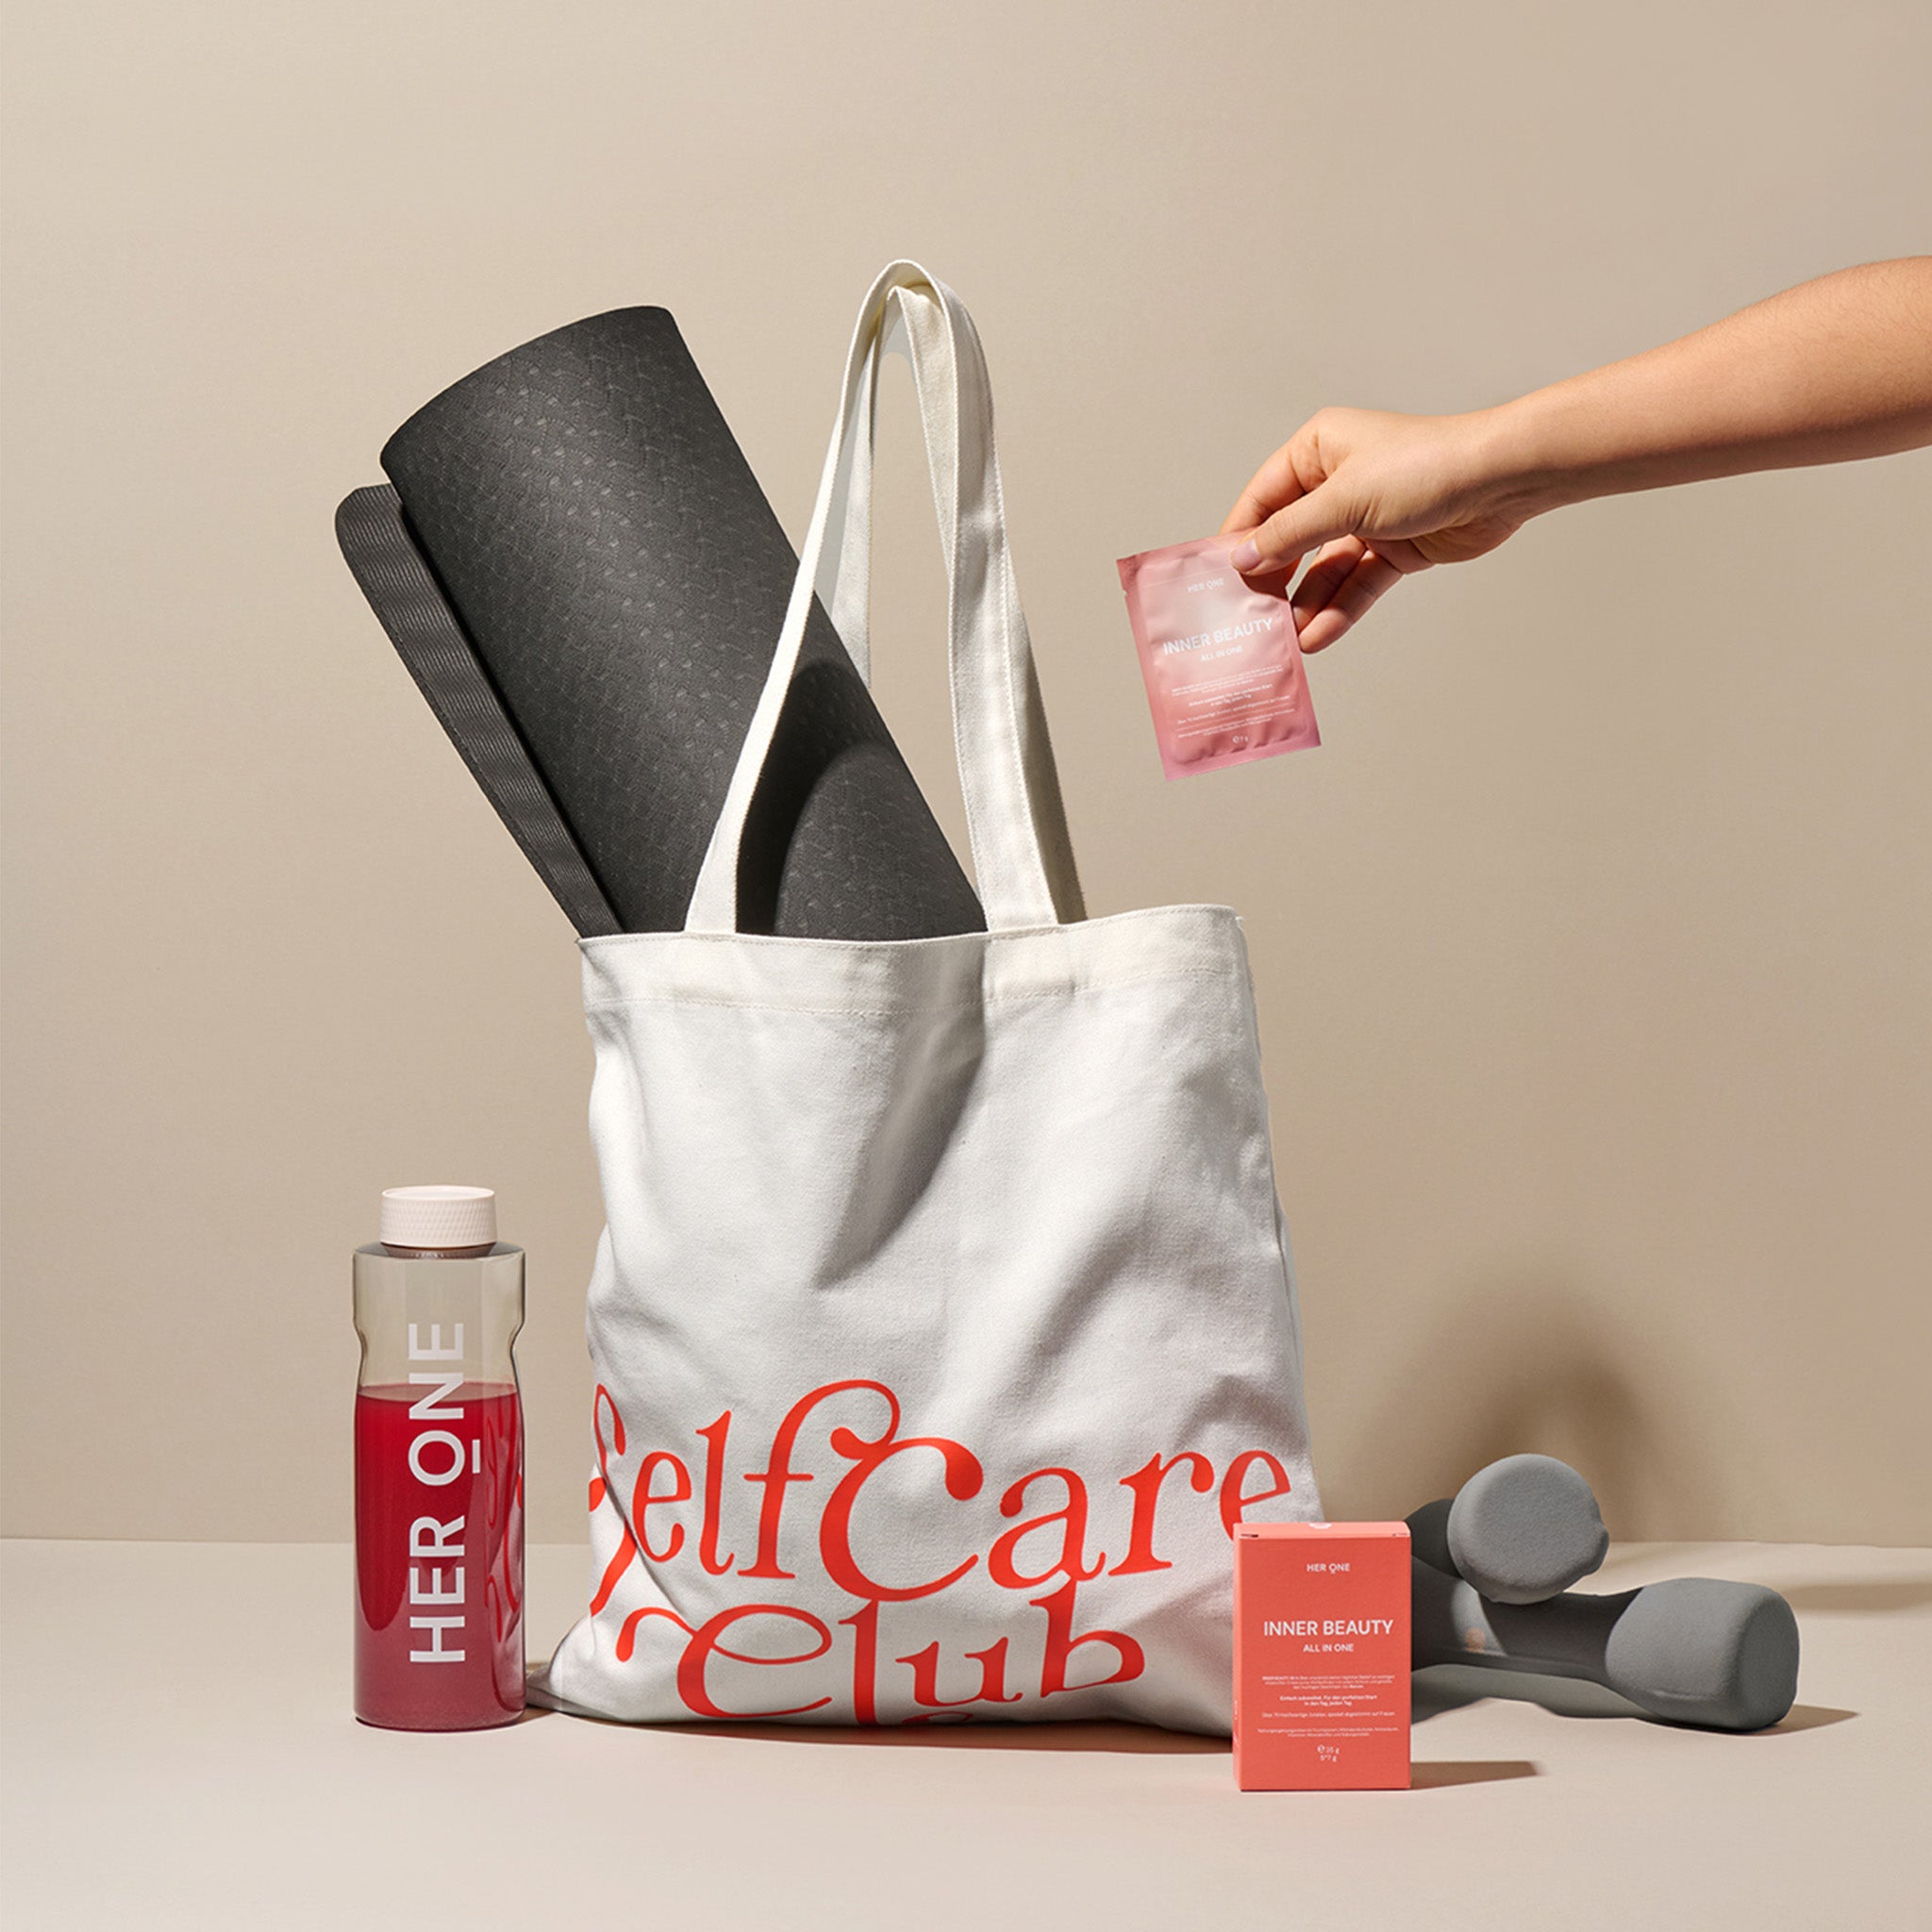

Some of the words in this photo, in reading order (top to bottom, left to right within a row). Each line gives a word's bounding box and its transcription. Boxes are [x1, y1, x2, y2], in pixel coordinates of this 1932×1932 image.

[1162, 633, 1211, 656] INNER
[1213, 617, 1274, 643] BEAUTY
[1200, 652, 1216, 663] ALL
[1216, 649, 1226, 659] IN
[1226, 645, 1243, 658] ONE
[408, 1324, 481, 1486] ONE
[1307, 1563, 1326, 1572] HER
[408, 1516, 466, 1663] HER
[1264, 1621, 1319, 1636] INNER
[1323, 1620, 1393, 1635] BEAUTY
[1303, 1643, 1321, 1653] ALL
[1322, 1643, 1332, 1652] IN
[1334, 1642, 1354, 1652] ONE
